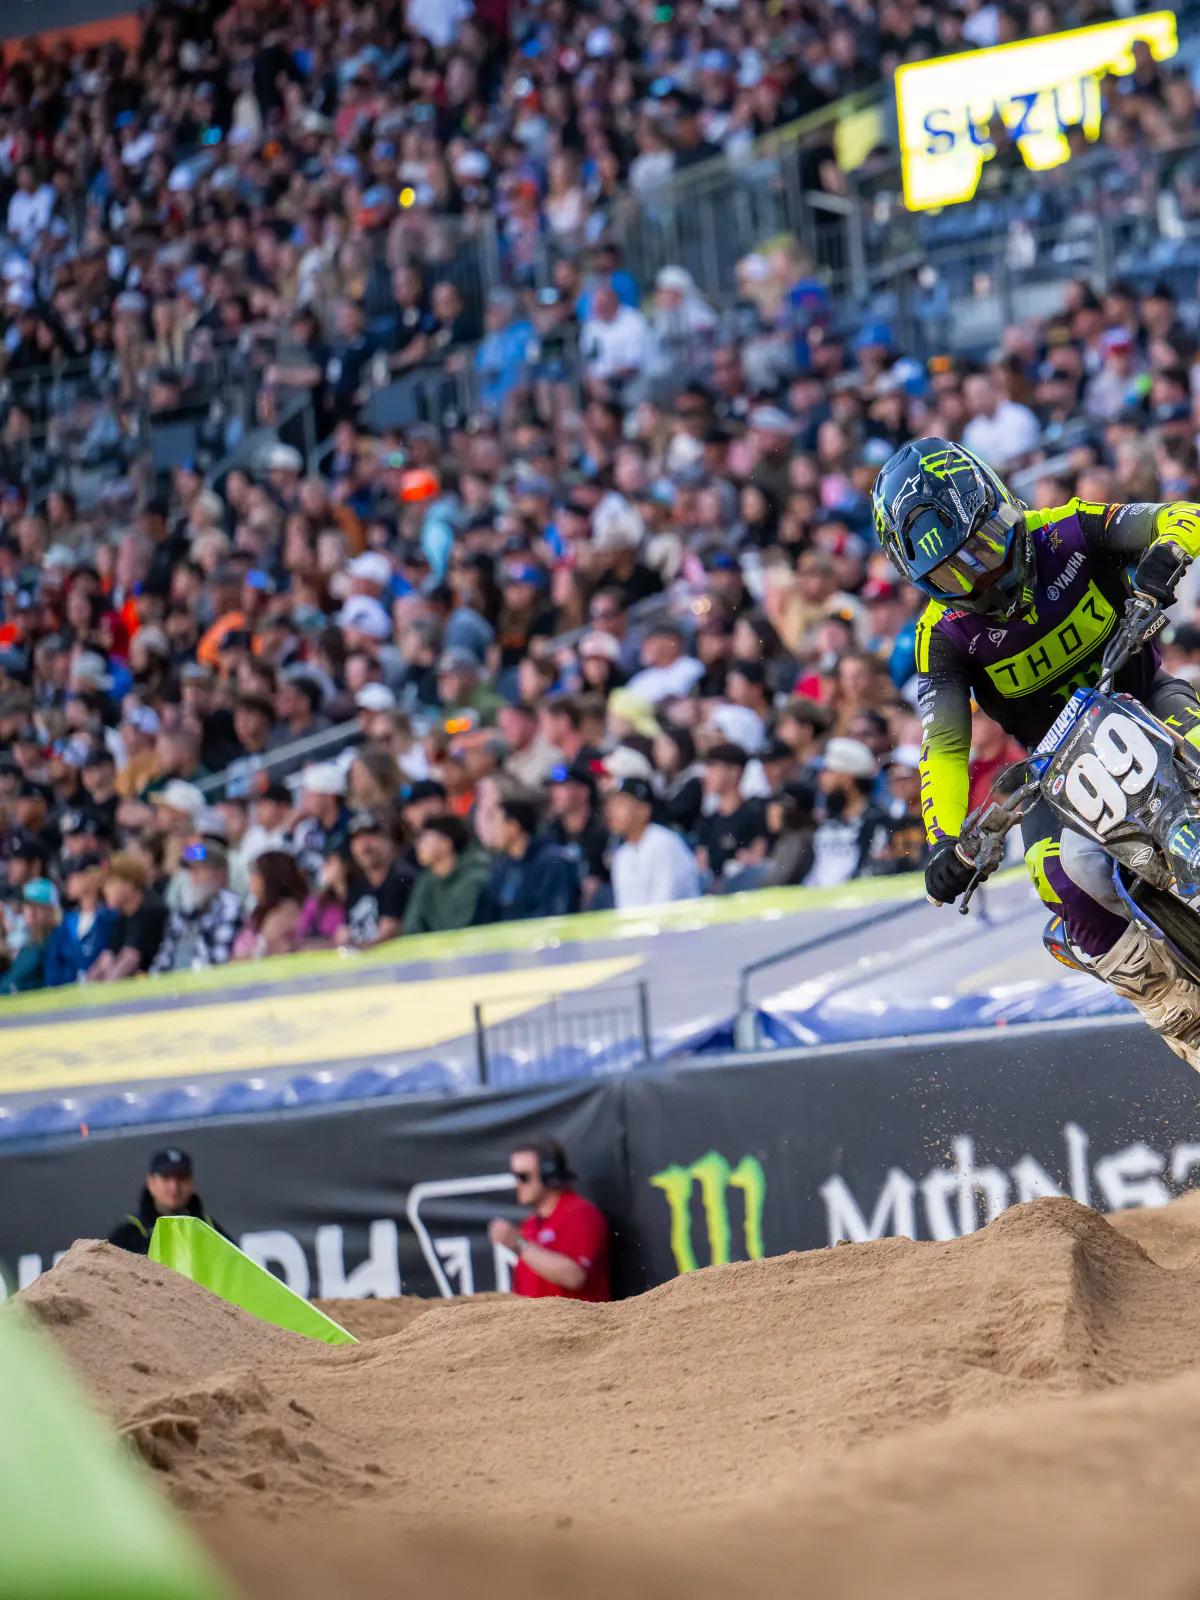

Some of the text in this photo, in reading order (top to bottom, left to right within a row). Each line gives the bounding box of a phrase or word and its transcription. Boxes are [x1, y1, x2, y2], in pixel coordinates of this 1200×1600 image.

[923, 76, 1090, 155] SUZU
[1053, 550, 1086, 589] YAMAHA
[995, 598, 1106, 686] THOR
[1065, 712, 1158, 836] 99
